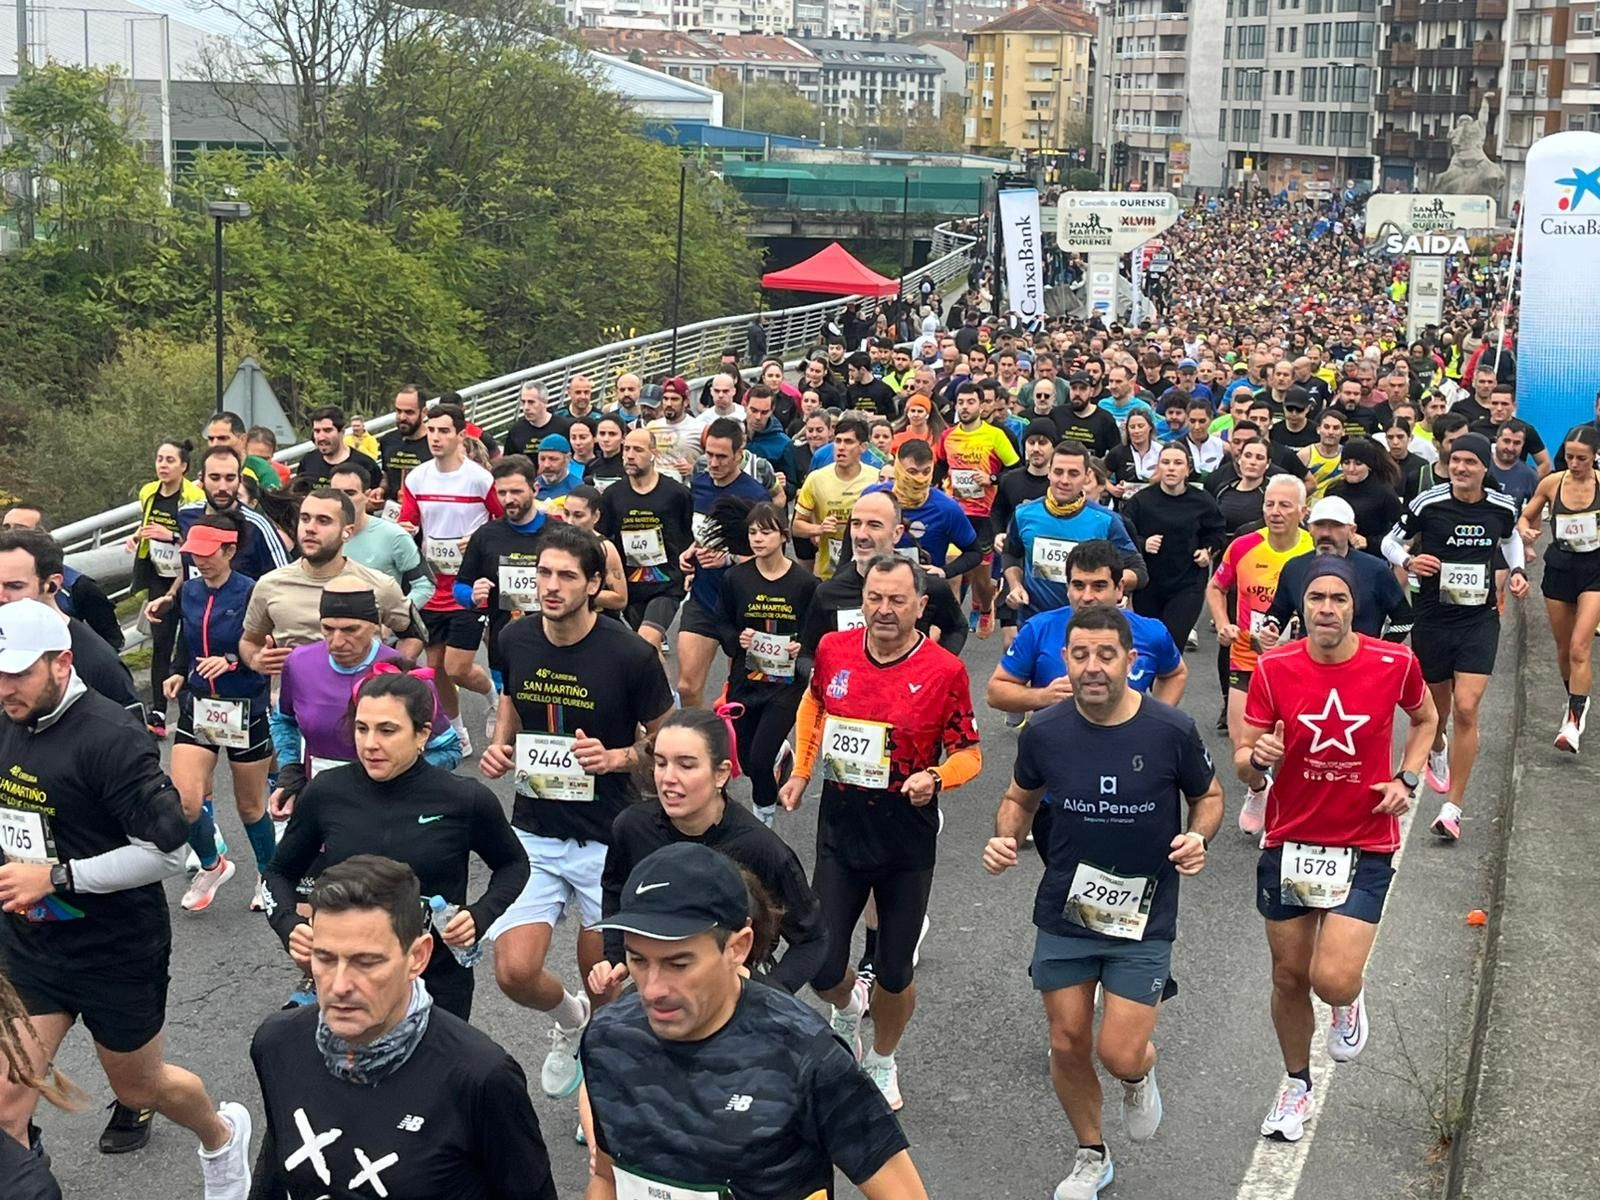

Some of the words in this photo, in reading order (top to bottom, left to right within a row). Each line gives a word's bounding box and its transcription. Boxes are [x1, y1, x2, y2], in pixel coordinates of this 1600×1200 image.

[1120, 199, 1166, 207] OURENSE
[1121, 216, 1156, 226] XLVIII
[1386, 229, 1470, 254] SAÍDA
[1015, 215, 1037, 317] CaixaBank
[1565, 524, 1584, 535] 431
[631, 539, 648, 550] 449
[1446, 536, 1492, 547] Apersa
[431, 546, 455, 557] 1396
[1042, 547, 1069, 562] 1659
[508, 576, 537, 589] 1695
[1448, 573, 1478, 585] 2930
[748, 603, 761, 611] SAN
[762, 604, 793, 613] MARTIÑO
[753, 640, 781, 656] 2632
[523, 681, 542, 692] SAN
[544, 682, 588, 698] MARTIÑO
[516, 692, 551, 703] CONCELLO
[552, 696, 562, 704] DE
[562, 698, 595, 710] OURENSE
[206, 709, 228, 724] 290
[832, 733, 870, 755] 2837
[528, 748, 572, 768] 9446
[1063, 798, 1096, 813] Alán
[1099, 801, 1156, 814] Penedo
[3, 825, 32, 849] 1765
[1294, 856, 1337, 876] 1578
[1082, 881, 1131, 906] 2987
